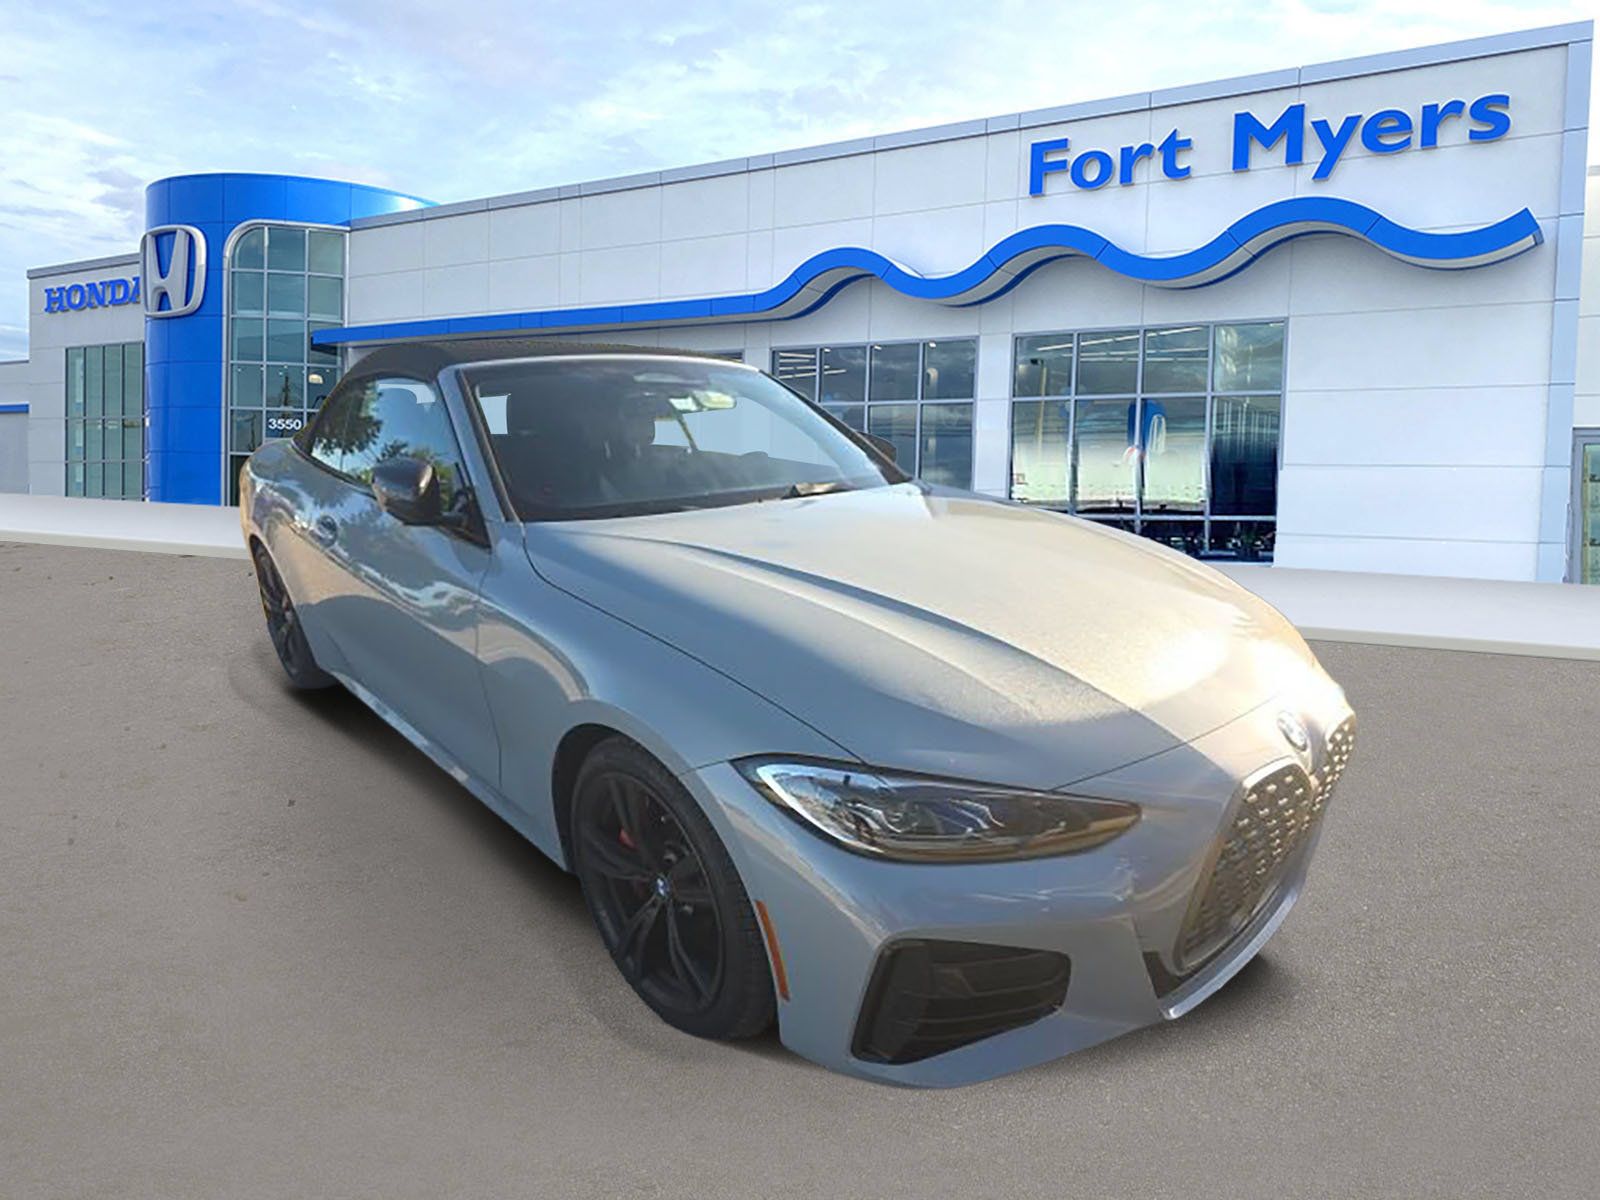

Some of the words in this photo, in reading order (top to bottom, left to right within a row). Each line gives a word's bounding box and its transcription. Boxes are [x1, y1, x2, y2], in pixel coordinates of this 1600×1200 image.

[1029, 129, 1192, 196] Fort
[1232, 94, 1511, 180] Myers
[268, 418, 302, 430] 3550
